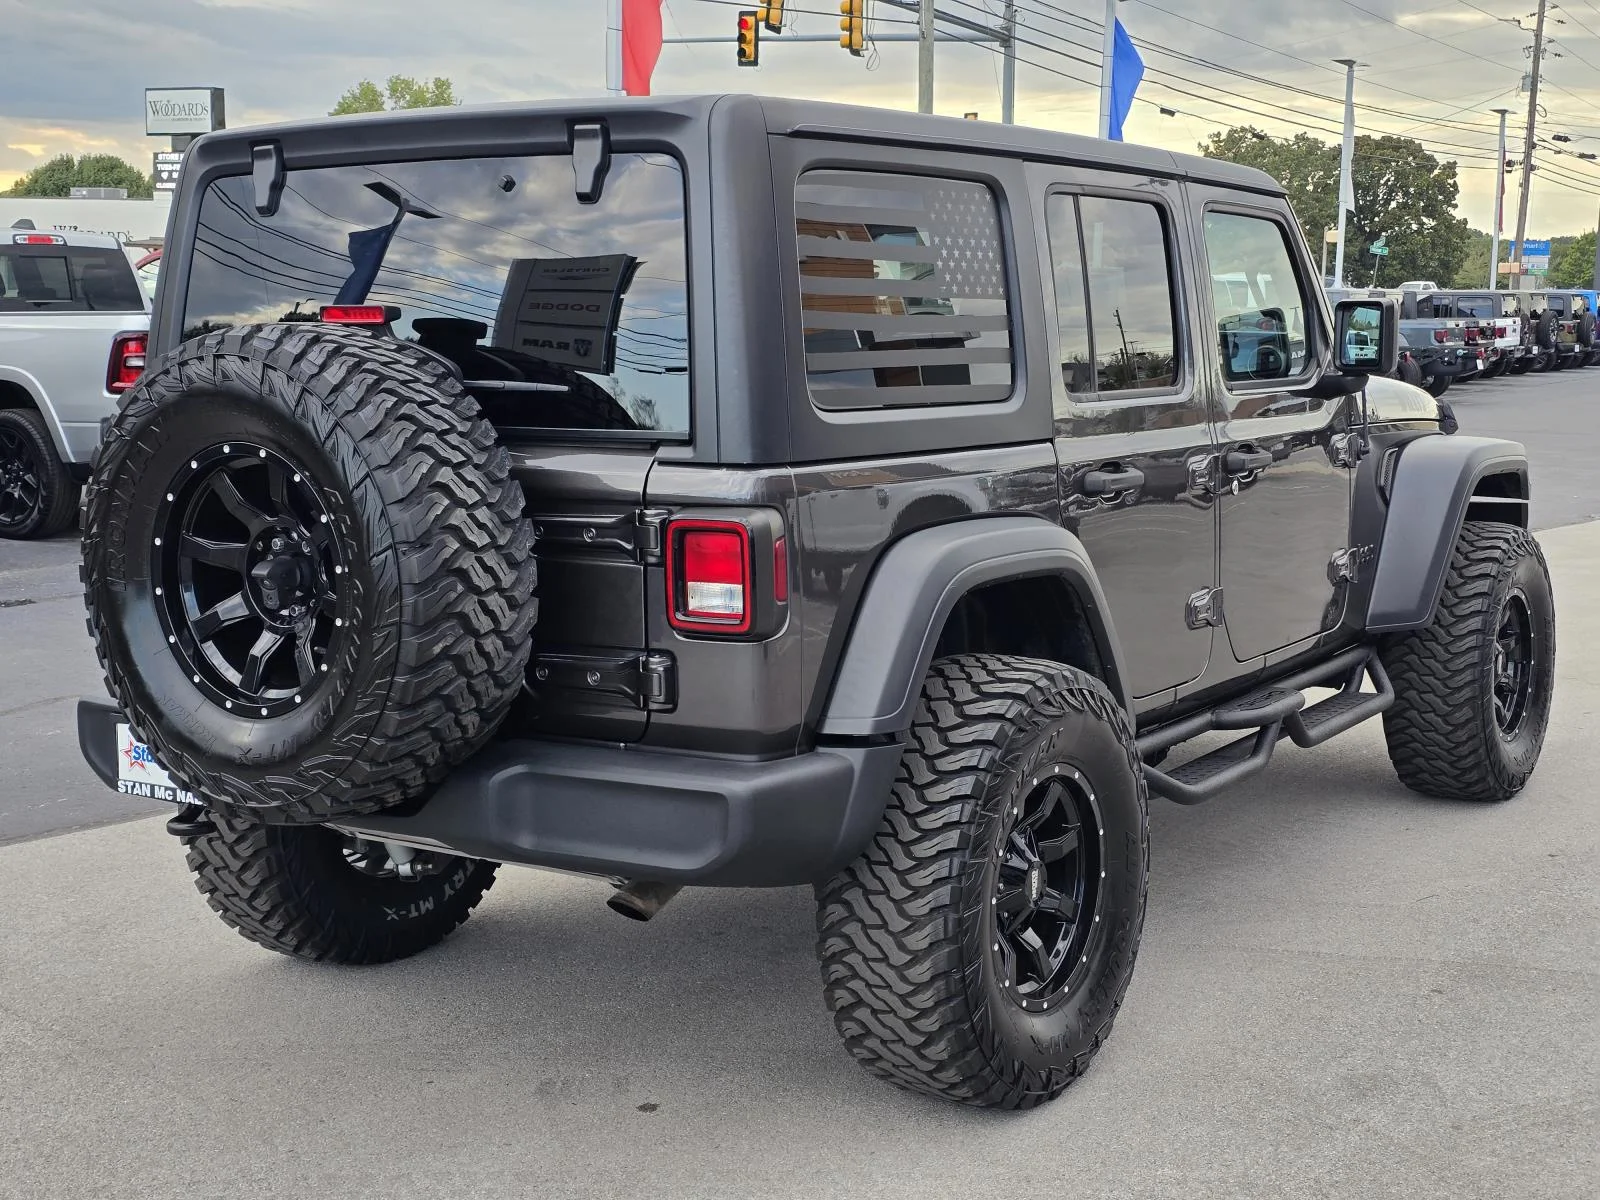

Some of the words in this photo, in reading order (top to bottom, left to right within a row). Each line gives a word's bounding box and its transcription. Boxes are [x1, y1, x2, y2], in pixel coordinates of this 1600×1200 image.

[117, 780, 151, 797] STAN
[154, 785, 173, 800] Mc
[382, 895, 435, 921] MT-X
